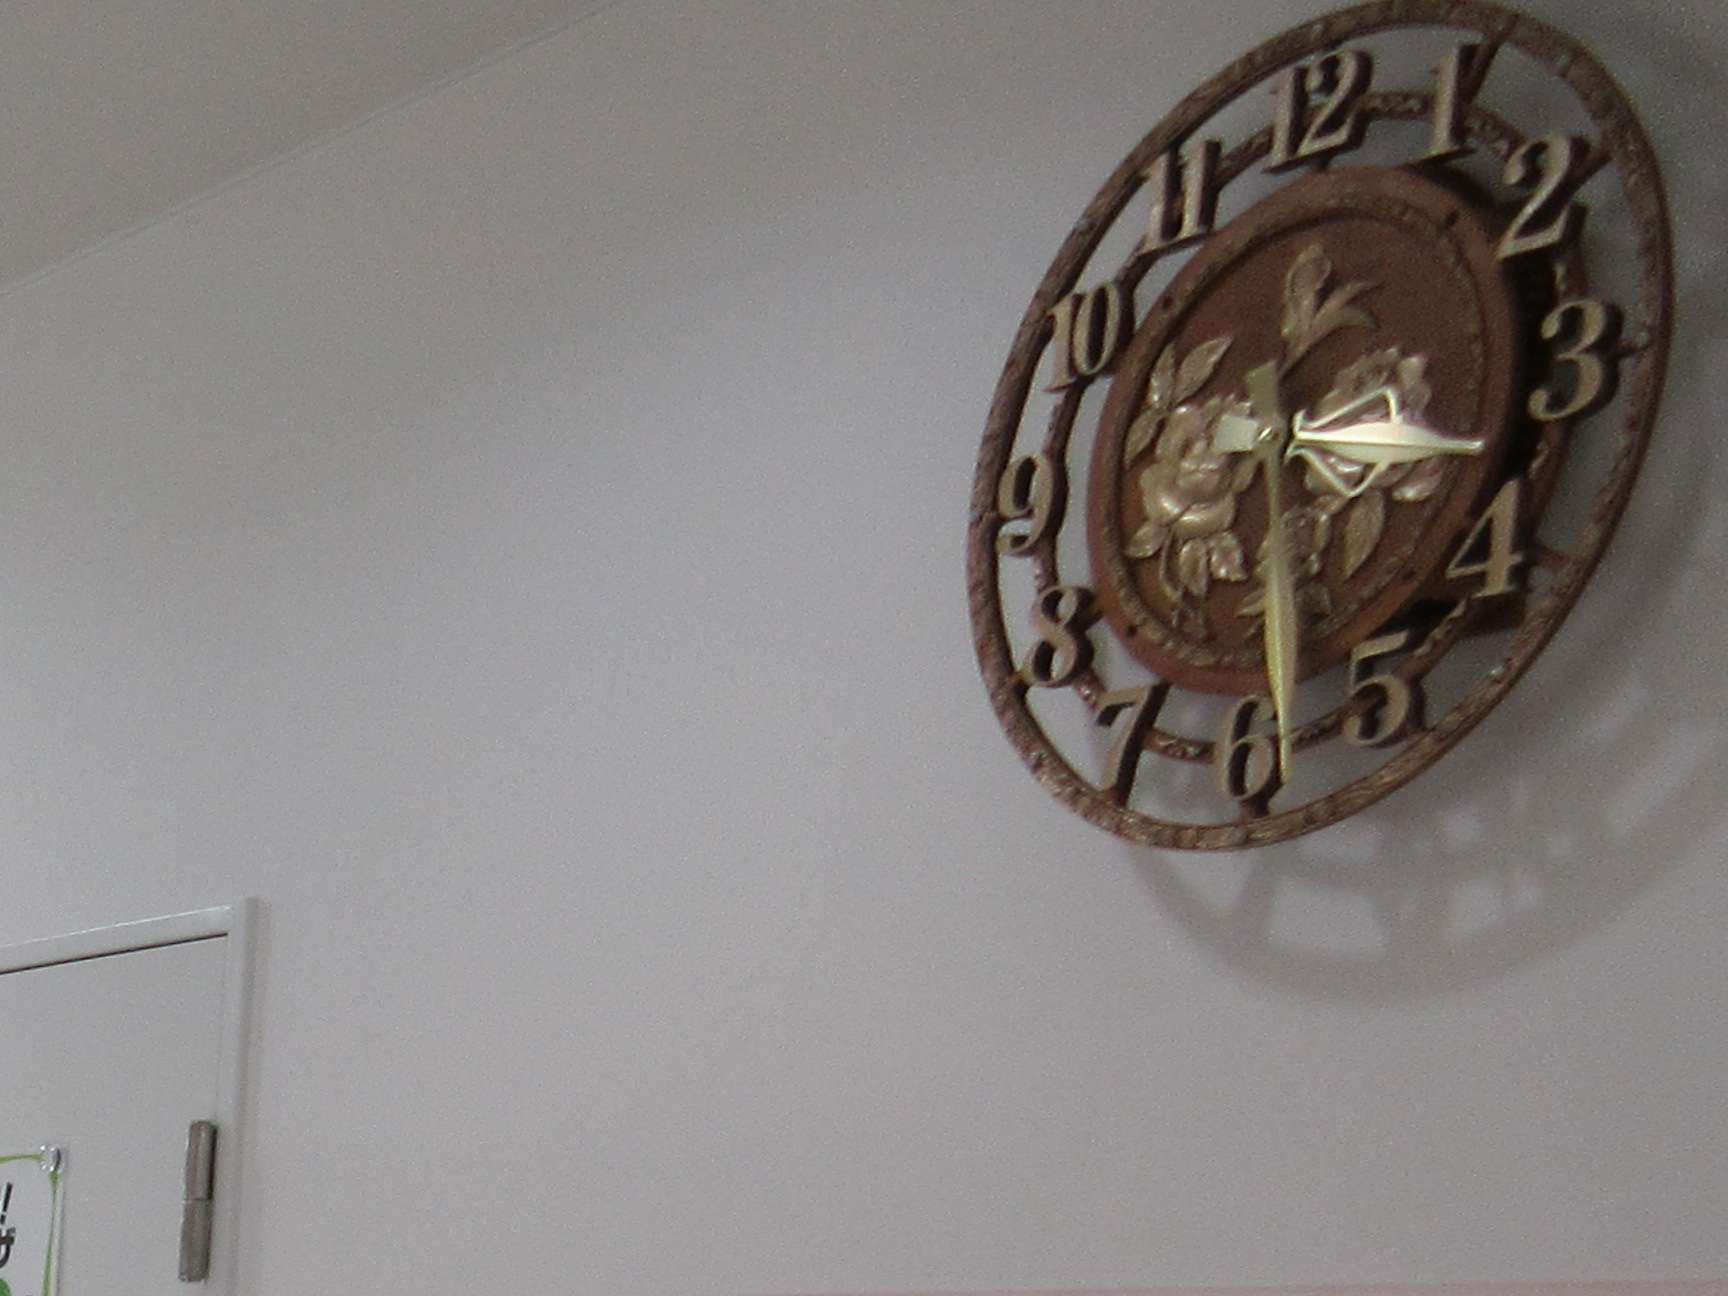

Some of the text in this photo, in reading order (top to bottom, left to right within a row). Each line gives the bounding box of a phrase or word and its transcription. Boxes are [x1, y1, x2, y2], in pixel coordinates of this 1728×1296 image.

[1268, 47, 1372, 172] 12
[1412, 43, 1480, 165] 1
[1138, 137, 1224, 256] 11
[1496, 132, 1587, 260] 2
[1046, 280, 1125, 392] 10
[1529, 299, 1622, 423] 3
[999, 453, 1056, 557] 9
[1446, 480, 1524, 598] 4
[1027, 585, 1094, 688] 8
[1348, 631, 1422, 748] 5
[1094, 682, 1166, 802] 7
[1214, 693, 1282, 802] 6
